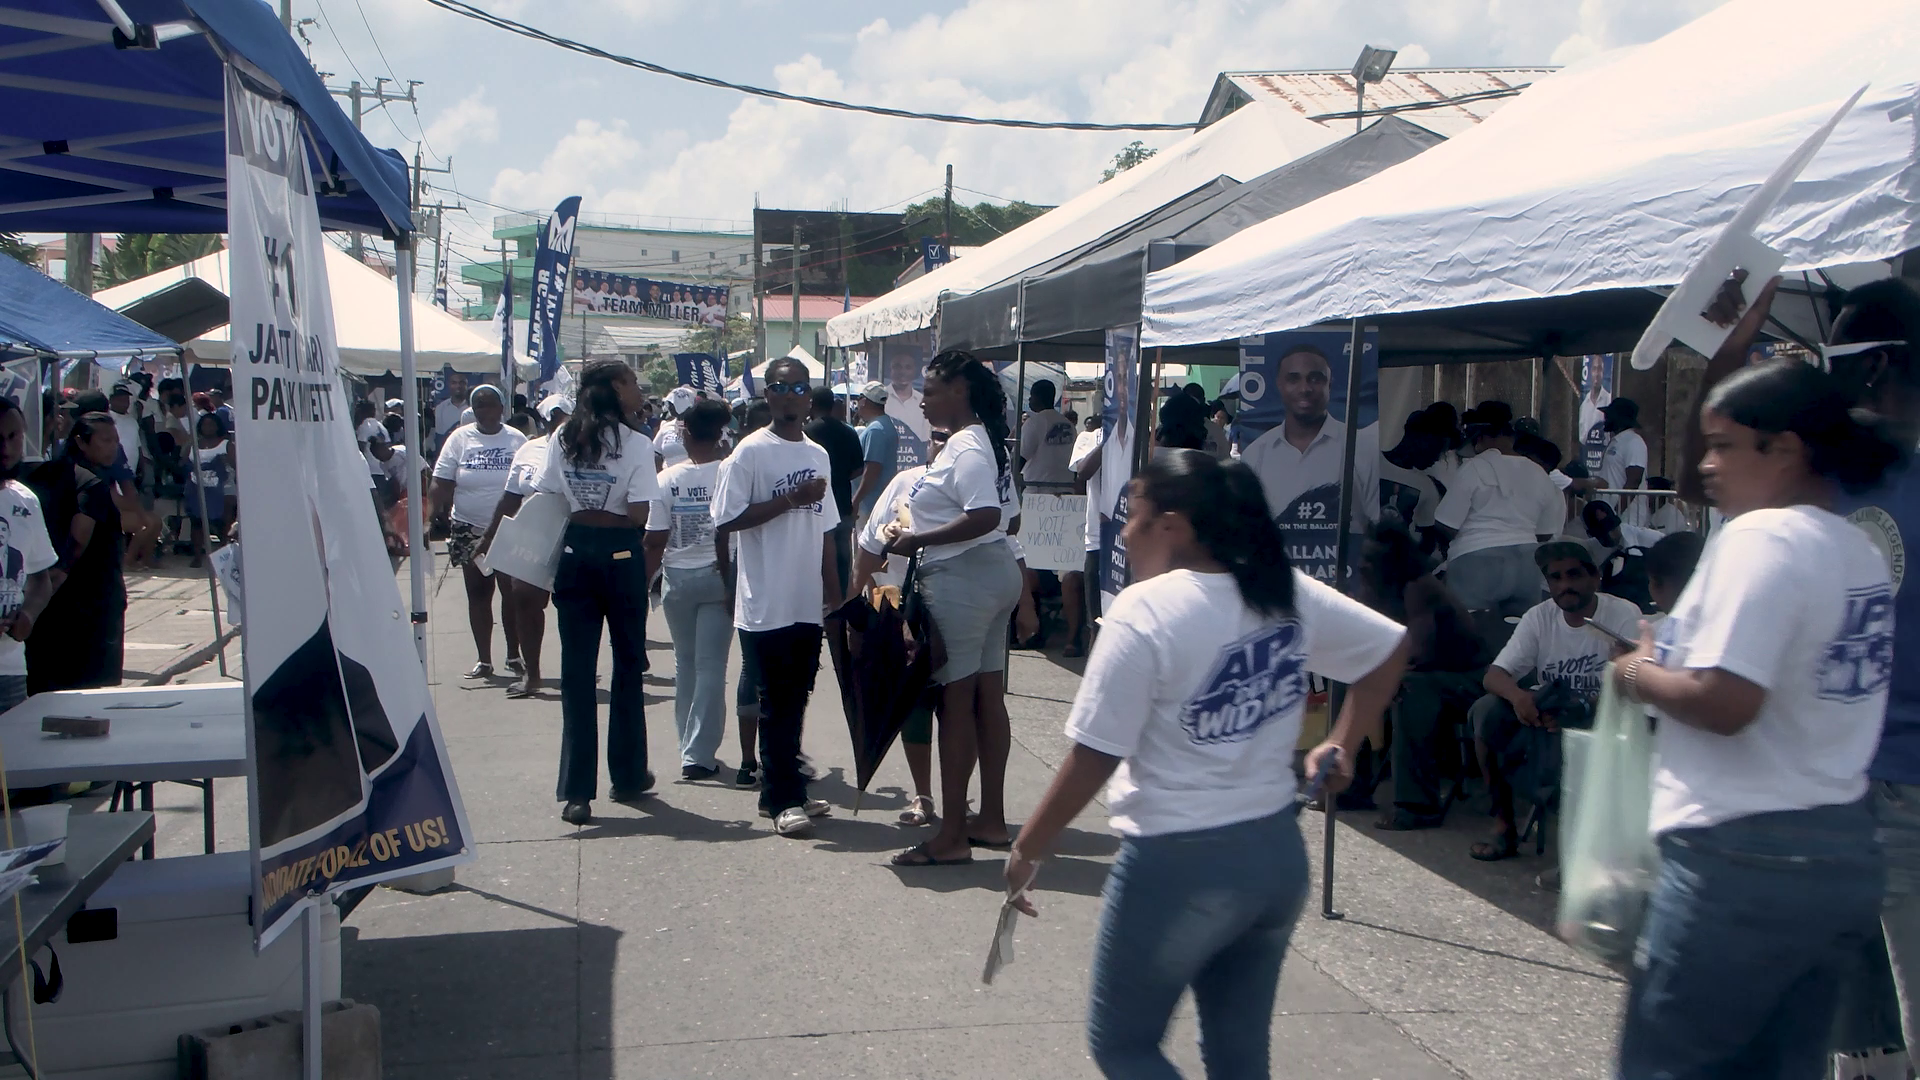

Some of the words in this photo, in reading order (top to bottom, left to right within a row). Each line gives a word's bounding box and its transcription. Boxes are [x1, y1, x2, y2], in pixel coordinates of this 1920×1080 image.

[602, 296, 643, 315] TEAM
[648, 301, 700, 322] MILLER
[687, 487, 708, 497] VOTE
[1298, 502, 1326, 519] #2
[1038, 514, 1071, 532] VOTE
[1558, 653, 1598, 674] VOTE
[369, 827, 401, 862] OF
[404, 815, 450, 853] US!
